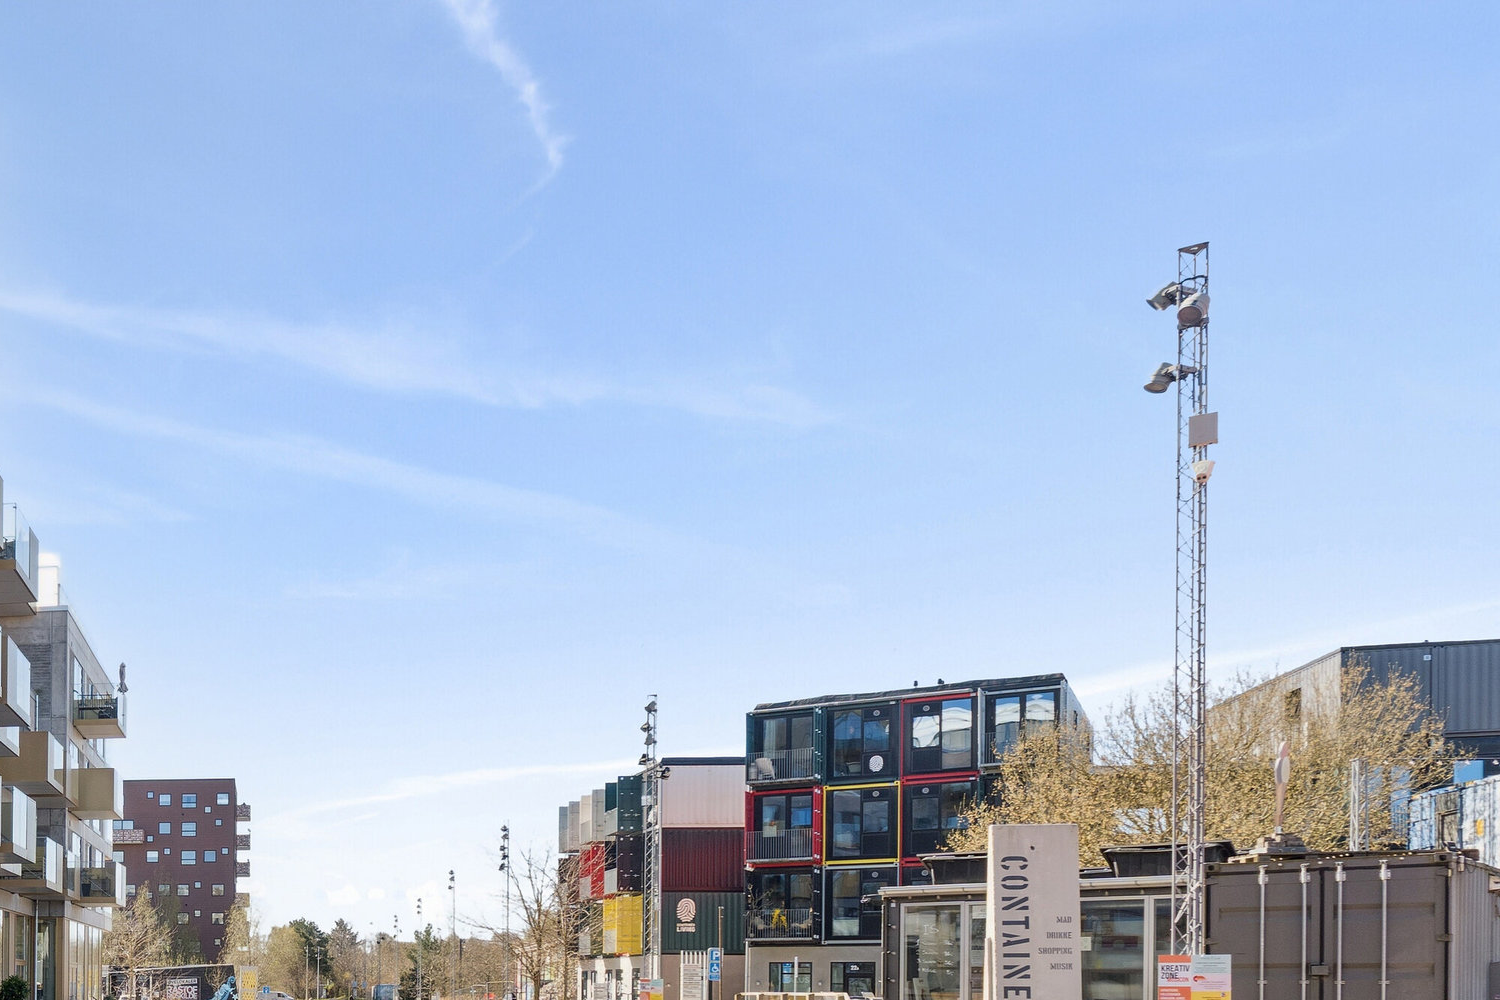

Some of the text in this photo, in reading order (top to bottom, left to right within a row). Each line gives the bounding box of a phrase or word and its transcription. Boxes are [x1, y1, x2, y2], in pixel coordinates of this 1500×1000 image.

[1056, 915, 1072, 923] MAD
[1046, 931, 1072, 939] DRIKKE
[1038, 947, 1073, 955] SHOPPING
[1160, 964, 1190, 972] KREATIV
[1160, 972, 1179, 980] ZONE
